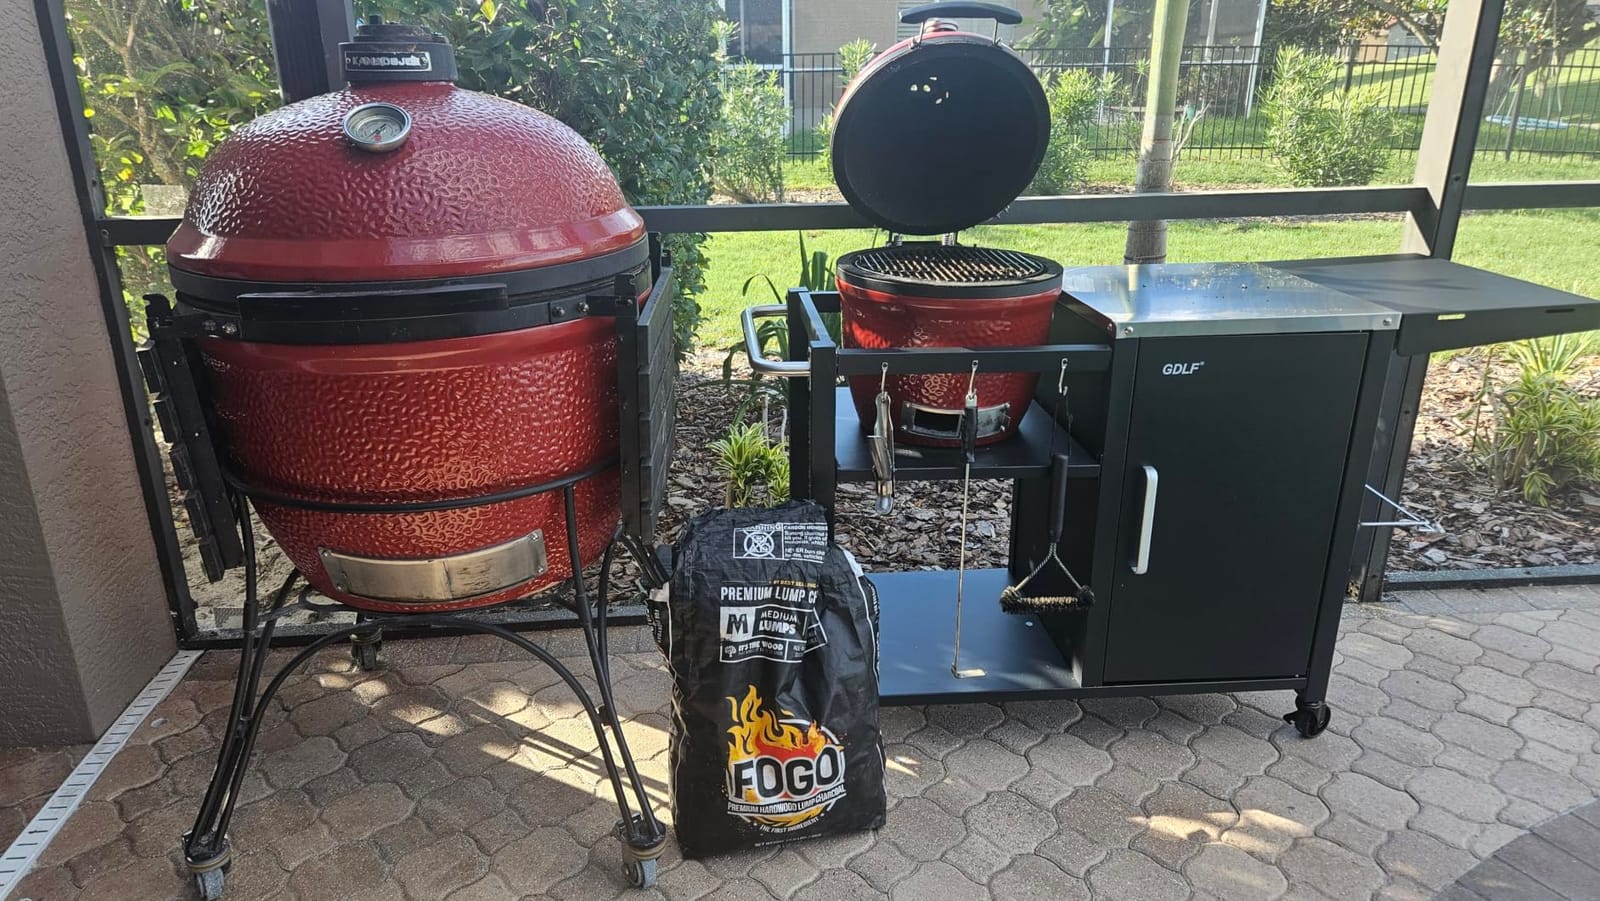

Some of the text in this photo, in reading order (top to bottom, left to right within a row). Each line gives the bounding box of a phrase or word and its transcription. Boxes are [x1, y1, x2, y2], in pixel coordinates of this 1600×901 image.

[1162, 363, 1200, 375] GDLF
[720, 586, 773, 601] PREMIUM
[775, 587, 806, 602] LUMP
[726, 613, 749, 635] M
[760, 610, 798, 623] MEDIUM
[759, 620, 797, 635] LUMPS
[761, 640, 784, 651] WOOD
[733, 746, 840, 800] FOGO
[727, 784, 847, 813] PREMIUM HARDWOOD LUMP CHARCOAL
